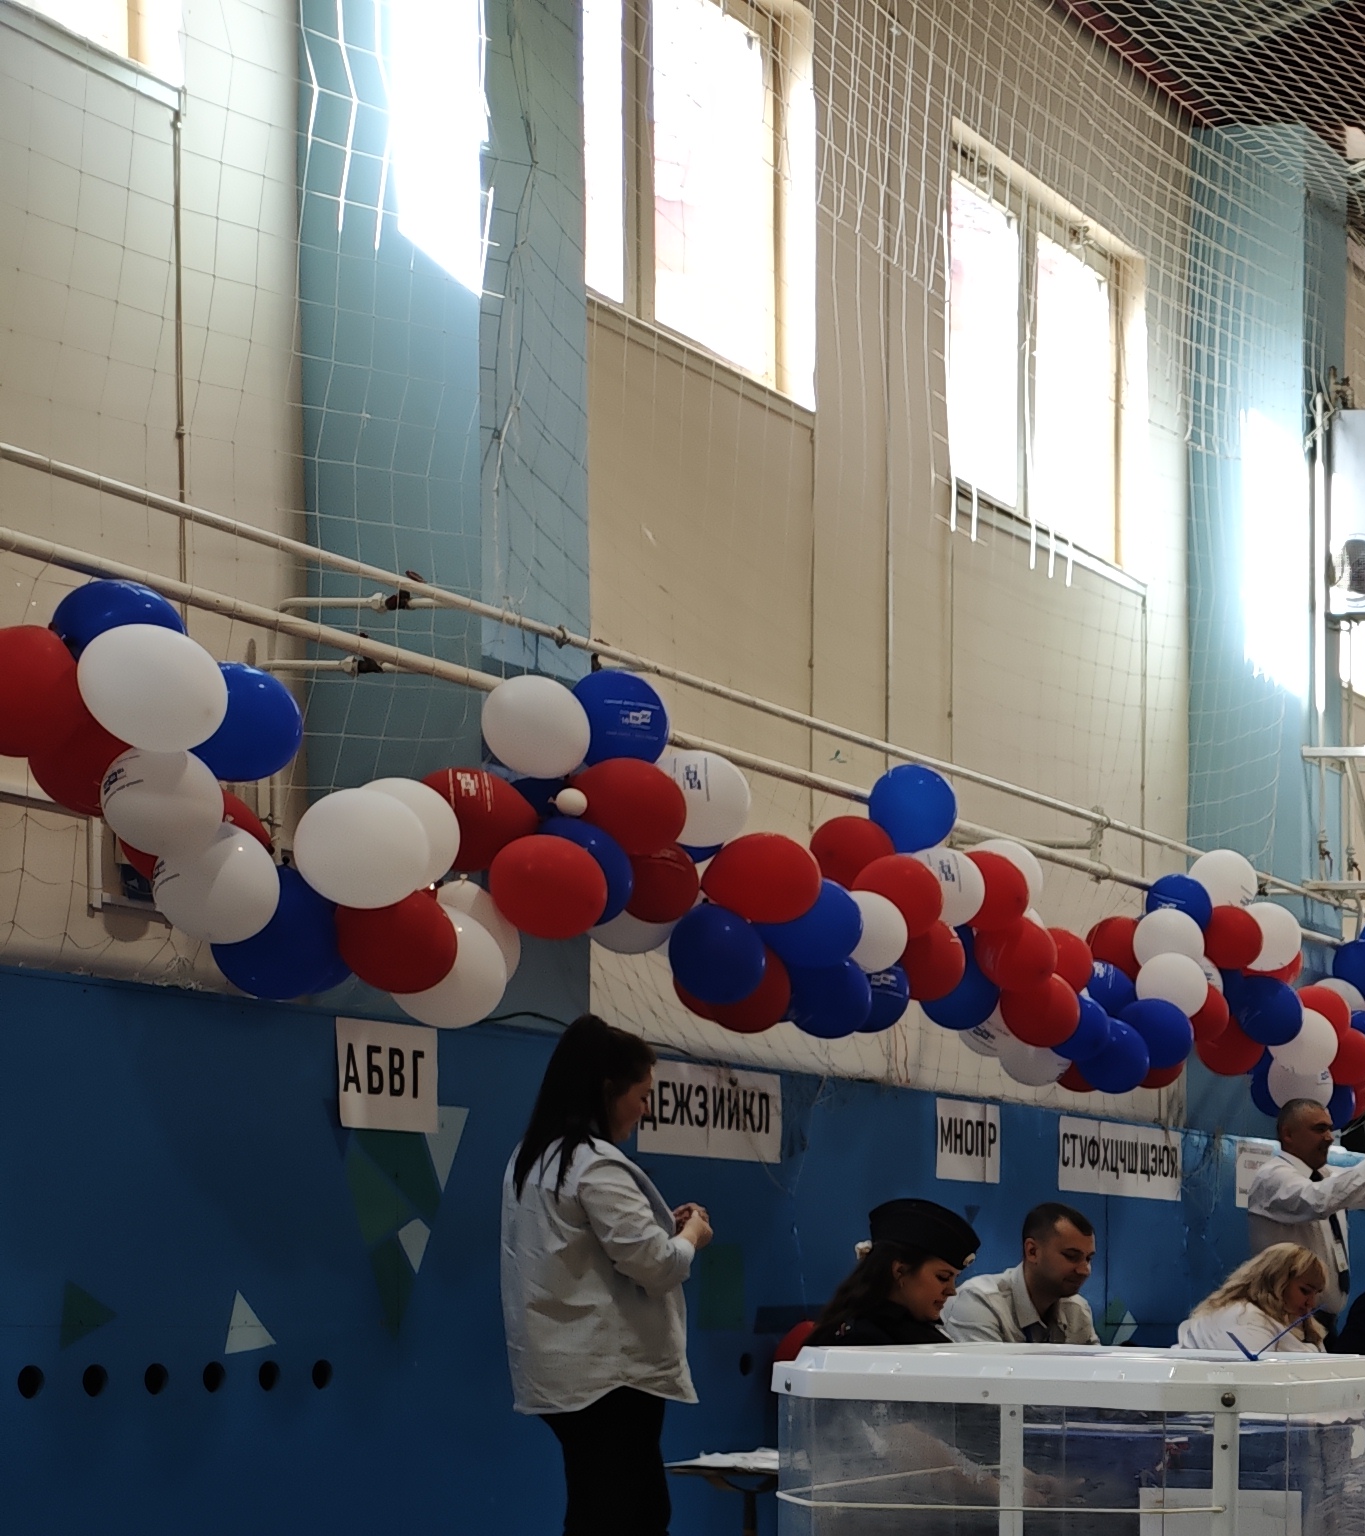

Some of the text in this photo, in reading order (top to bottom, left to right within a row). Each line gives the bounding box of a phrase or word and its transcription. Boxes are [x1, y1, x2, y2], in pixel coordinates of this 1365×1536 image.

[343, 1042, 425, 1099] АБВГ
[639, 1077, 770, 1134] ДЕЖЗИЙКЛ
[940, 1116, 997, 1158] МНОПР
